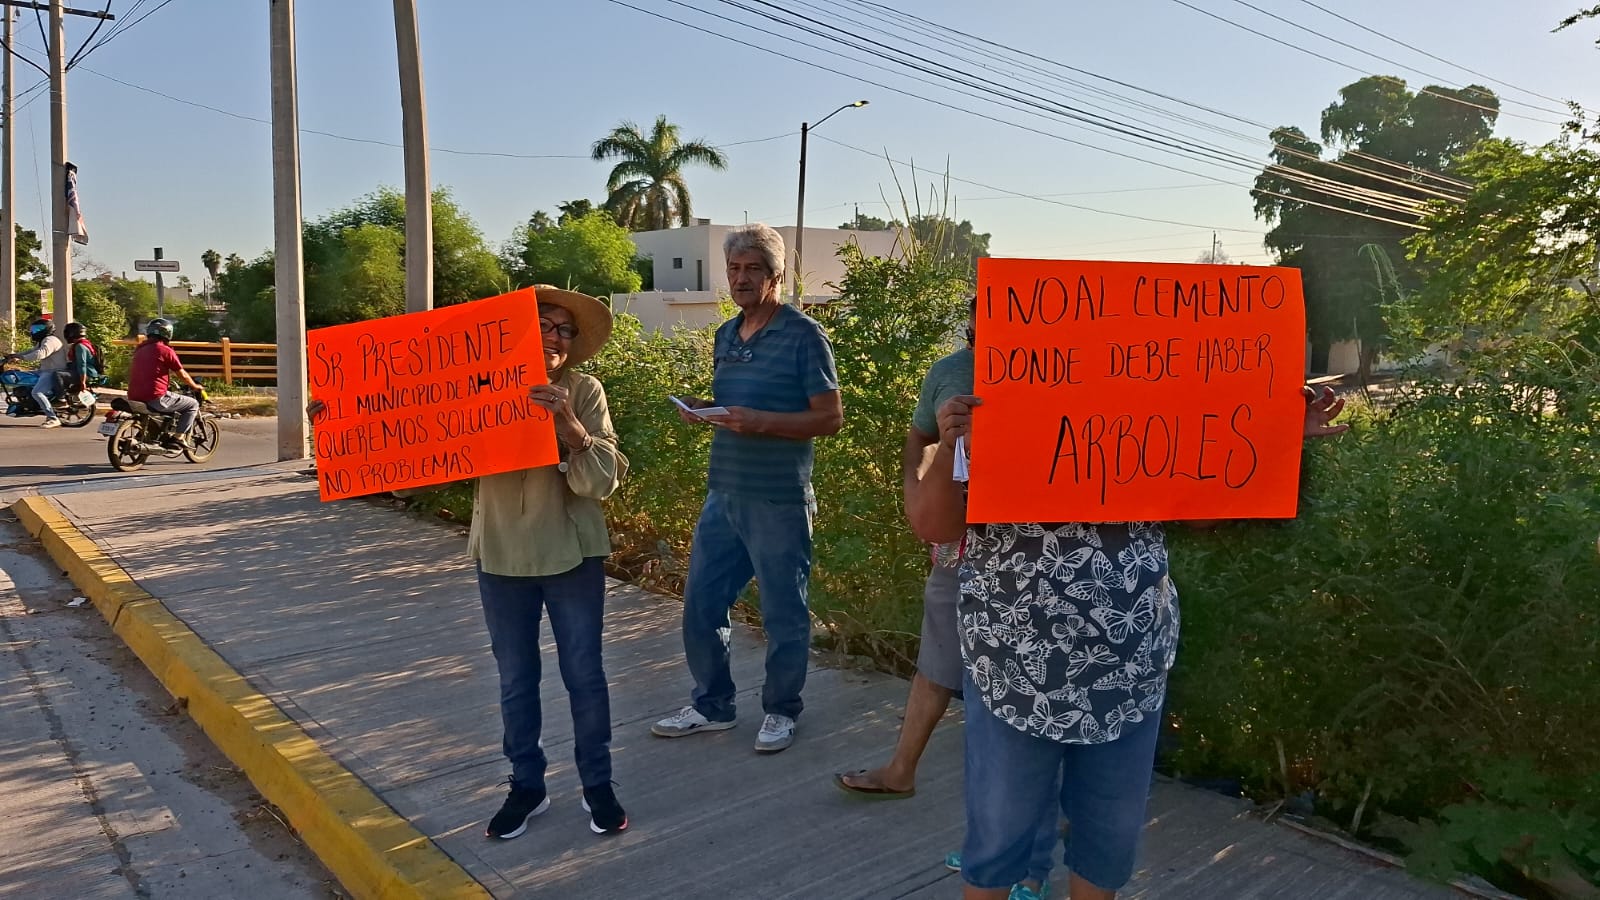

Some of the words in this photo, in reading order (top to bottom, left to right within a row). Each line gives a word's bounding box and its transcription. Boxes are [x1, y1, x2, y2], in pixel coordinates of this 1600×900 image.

[1133, 274, 1286, 323] CEMENTO
[313, 342, 345, 392] SR
[356, 319, 513, 391] PRESIDENTE
[982, 345, 1083, 388] DONDE
[1104, 337, 1184, 382] DEBE
[1196, 332, 1275, 399] HABER
[356, 381, 442, 416] MUNICIPIO
[446, 378, 463, 401] DE
[467, 364, 529, 397] AHOME
[317, 414, 429, 461] QUEREMOS
[1048, 403, 1258, 506] ARBOLES
[324, 468, 352, 497] NO
[358, 445, 474, 491] PROBLEMAS
